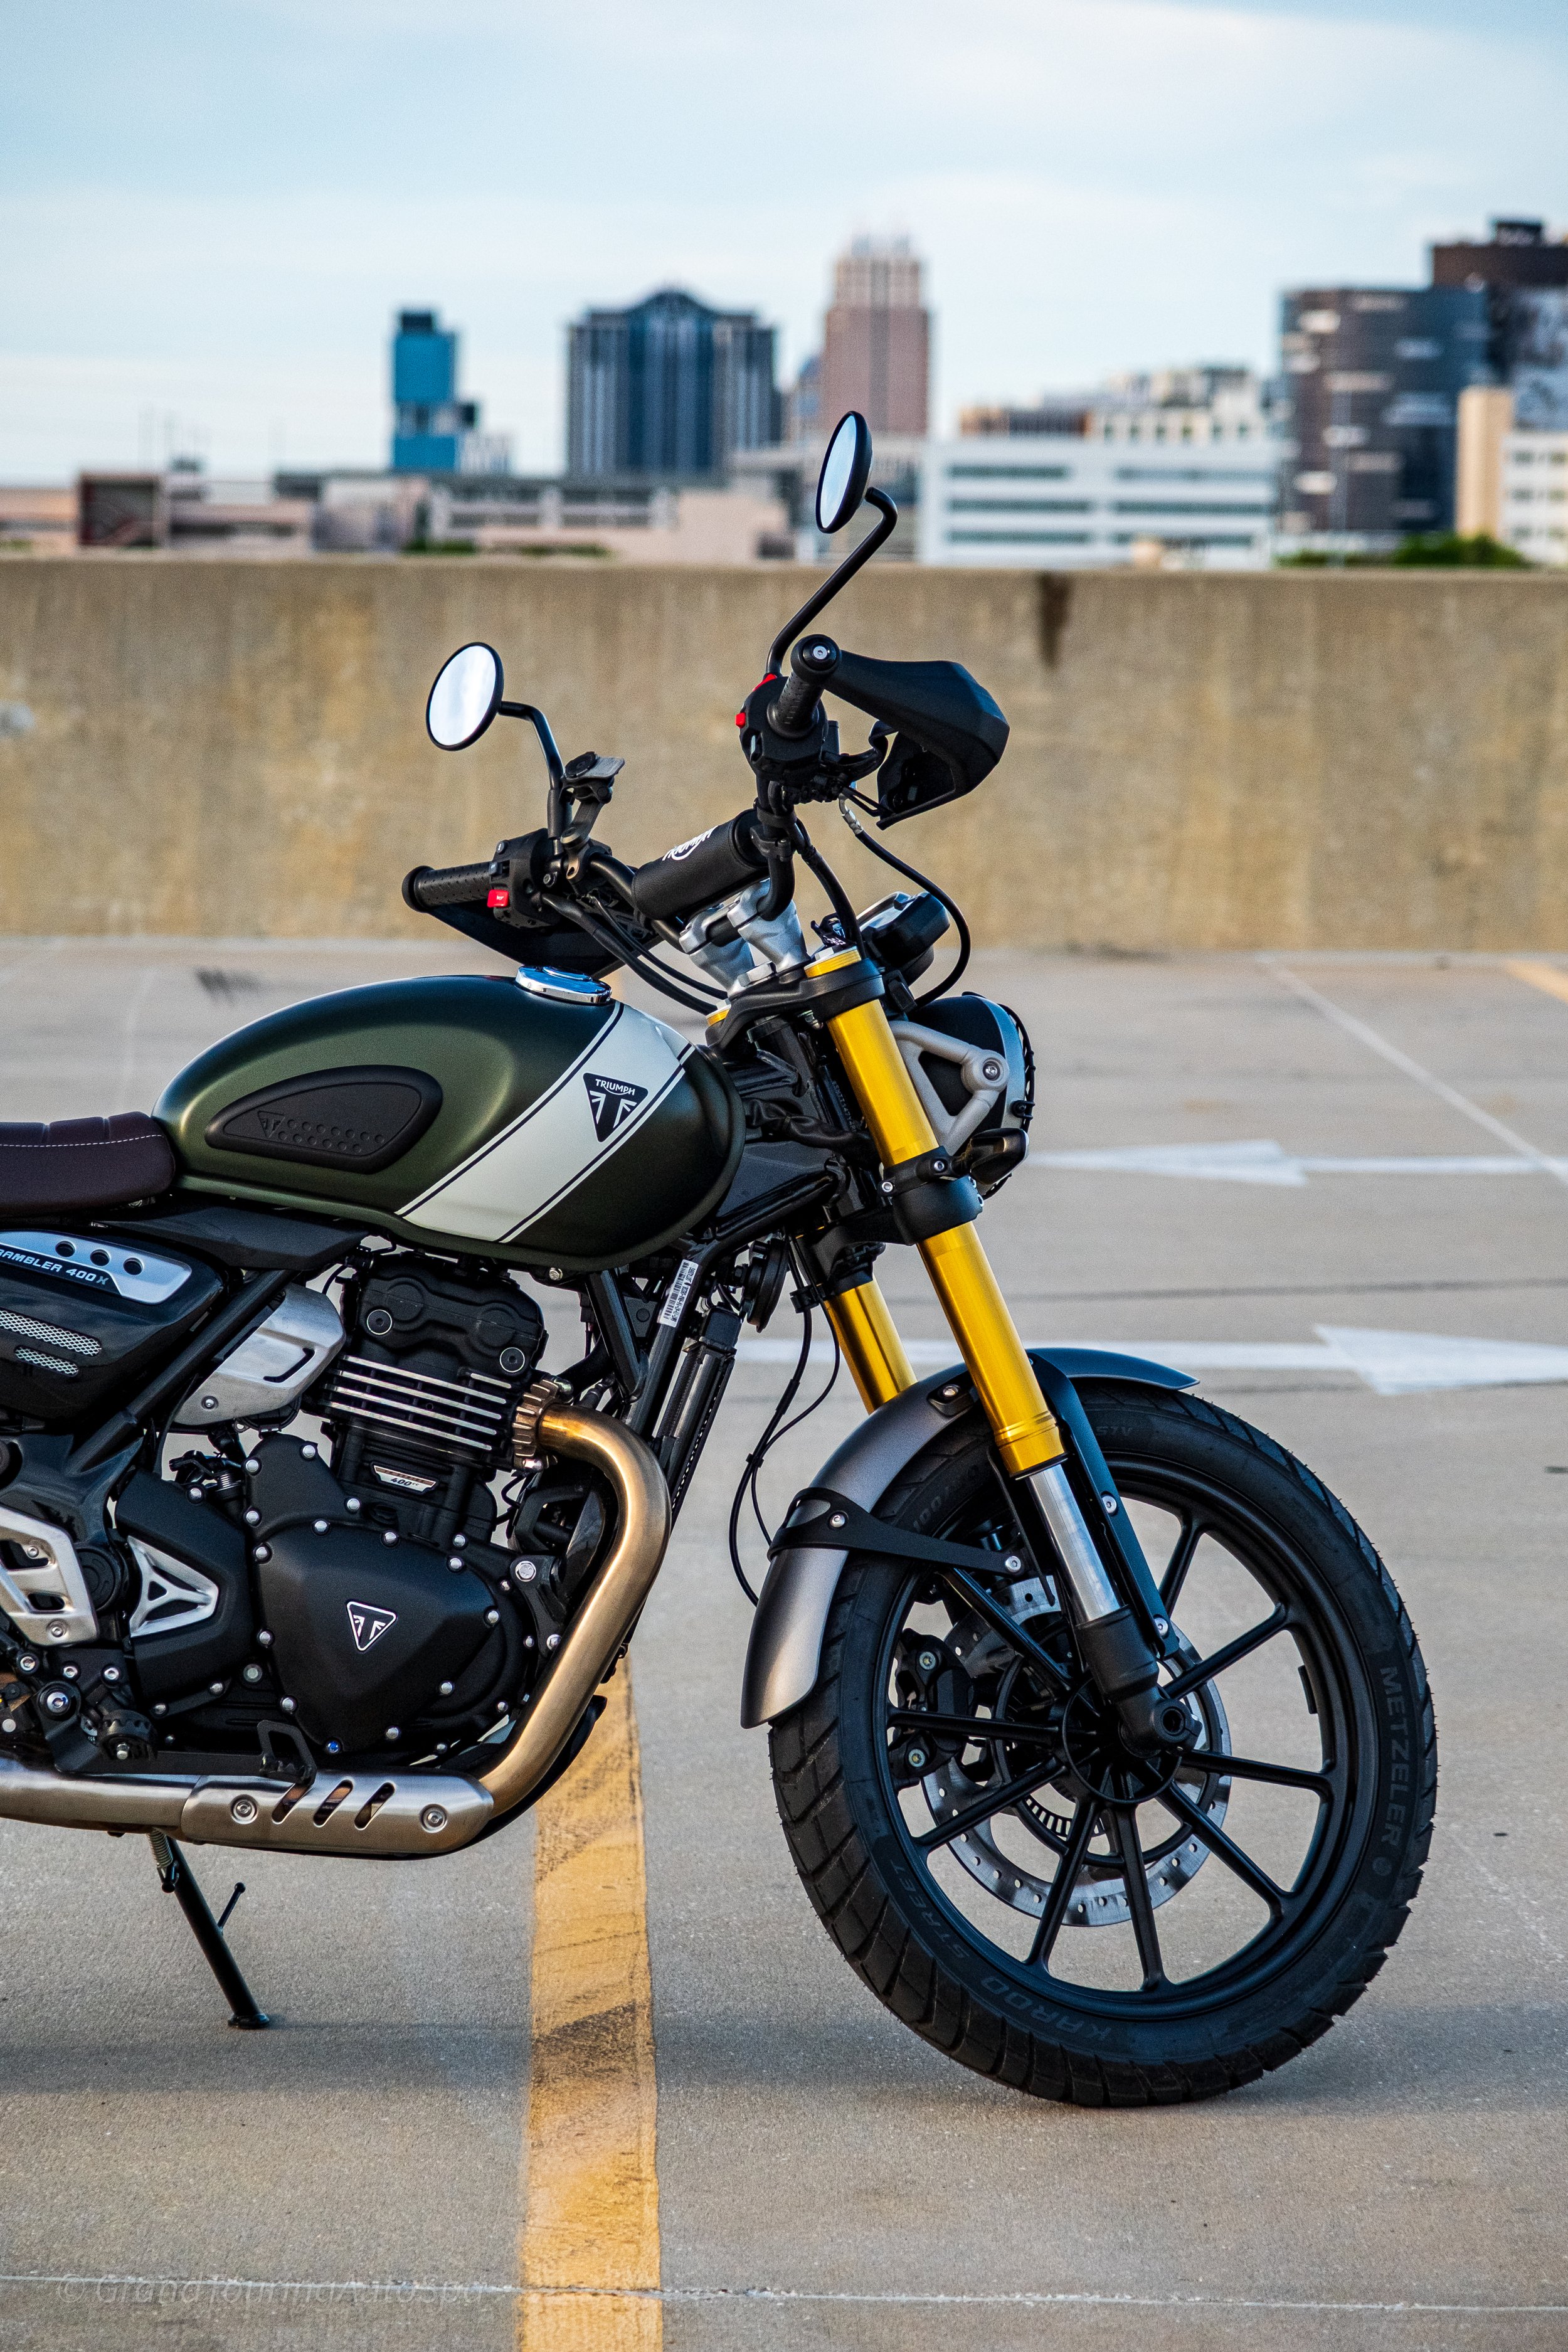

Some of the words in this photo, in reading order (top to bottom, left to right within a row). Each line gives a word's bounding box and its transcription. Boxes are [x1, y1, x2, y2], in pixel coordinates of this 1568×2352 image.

[595, 1078, 635, 1096] TRIUMPH
[1380, 1666, 1410, 1848] METZELER
[889, 1859, 971, 1961] STREET
[979, 1976, 1113, 2043] KAROO
